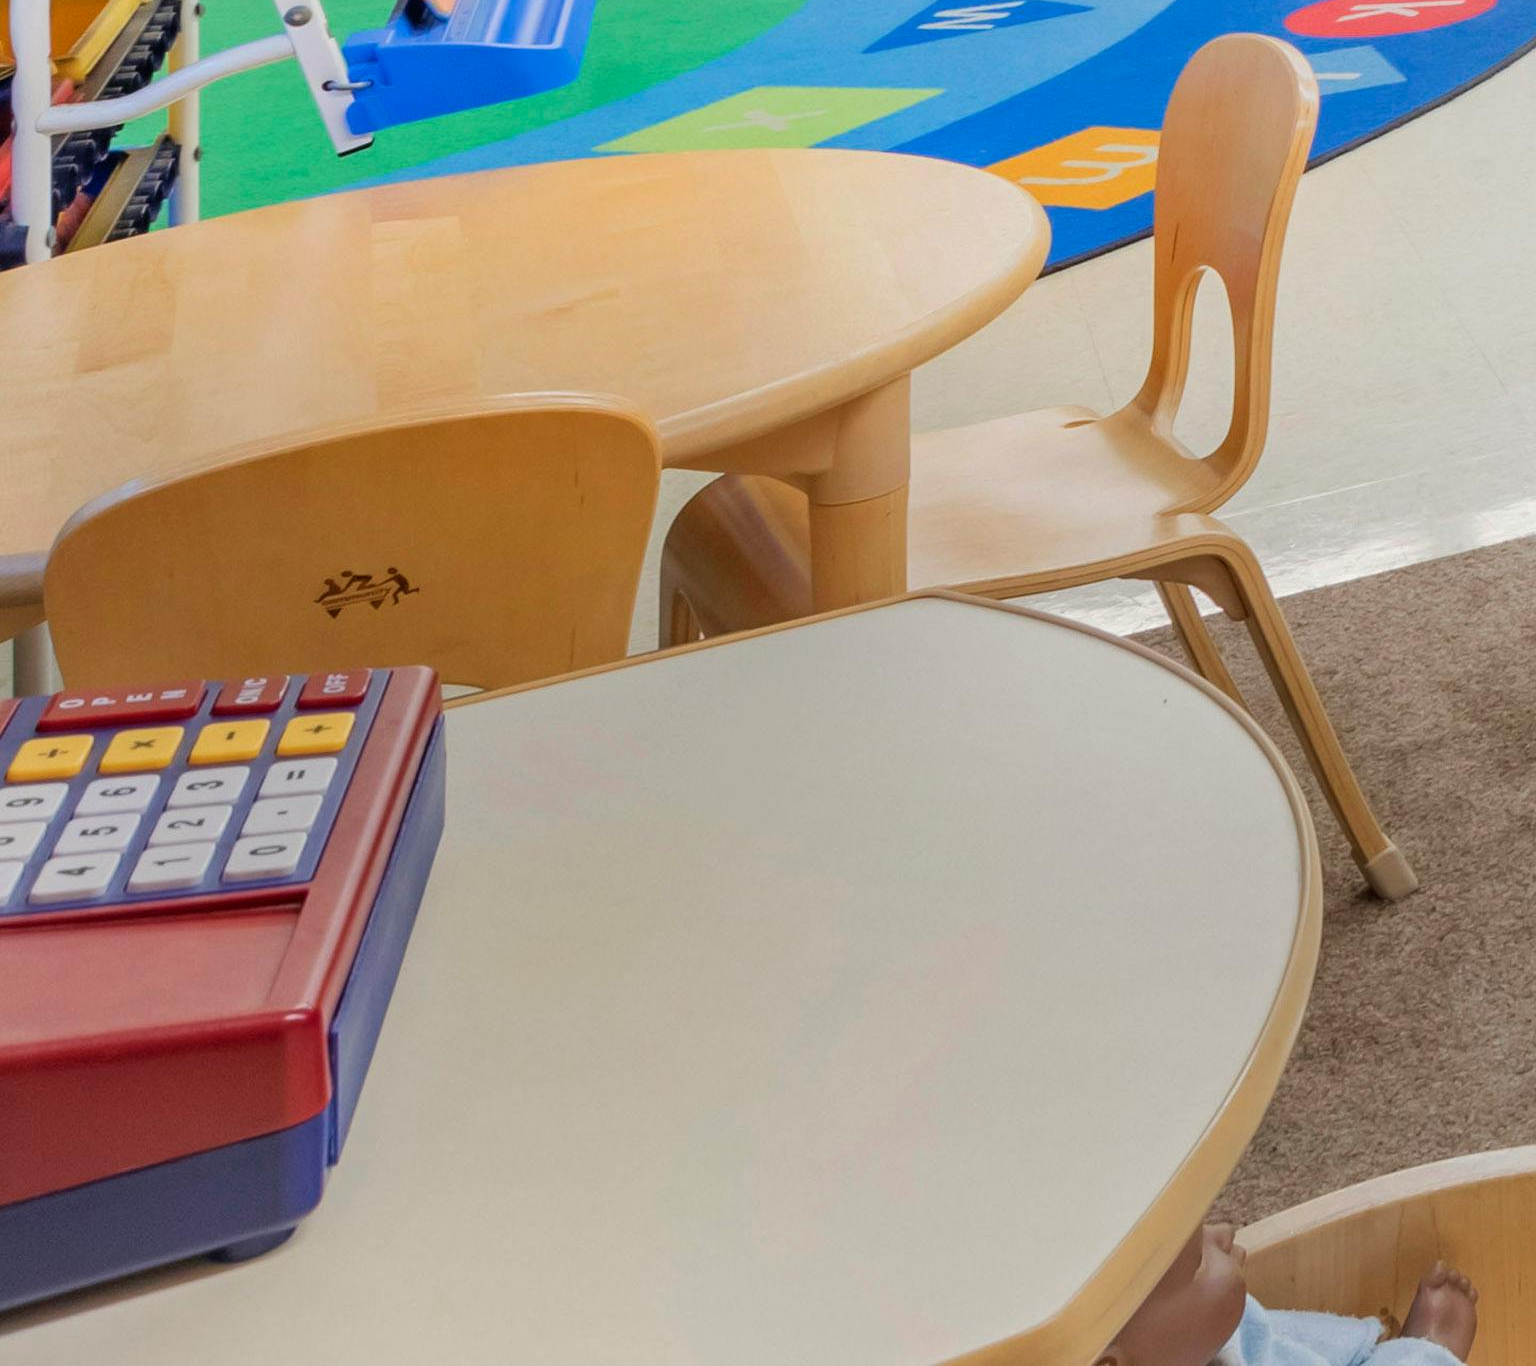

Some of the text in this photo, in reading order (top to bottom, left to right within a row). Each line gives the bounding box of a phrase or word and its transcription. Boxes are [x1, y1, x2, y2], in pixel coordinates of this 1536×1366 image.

[916, 0, 1029, 31] w
[1336, 0, 1466, 23] k
[322, 673, 349, 693] OFF
[100, 787, 137, 797] 6
[187, 780, 224, 791] 3
[6, 796, 44, 809] 9
[79, 825, 119, 837] 5
[167, 818, 206, 831] 2
[249, 844, 287, 857] 0
[153, 856, 191, 866] 1
[56, 866, 96, 877] 4
